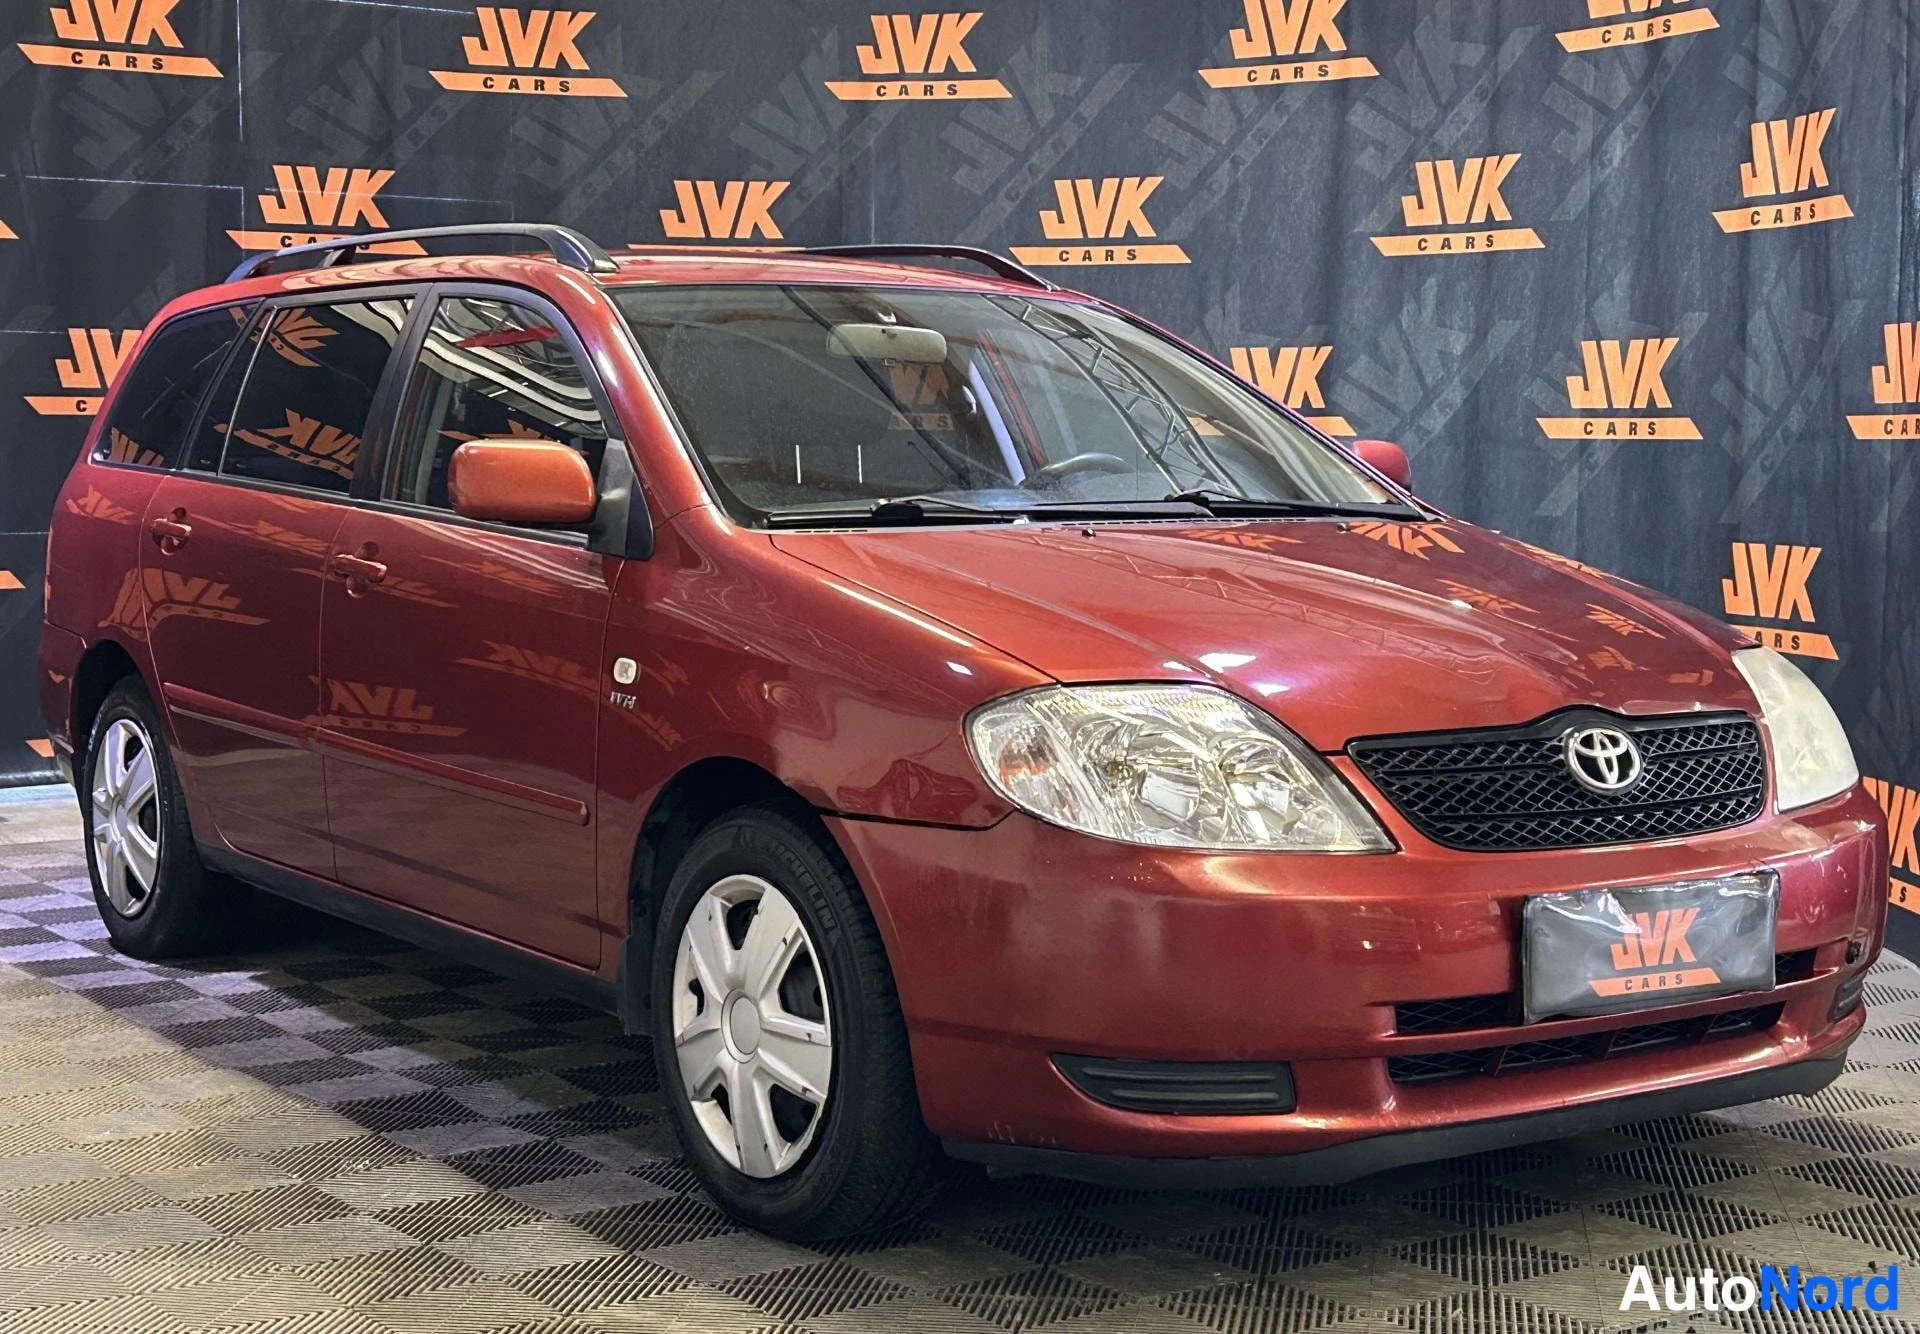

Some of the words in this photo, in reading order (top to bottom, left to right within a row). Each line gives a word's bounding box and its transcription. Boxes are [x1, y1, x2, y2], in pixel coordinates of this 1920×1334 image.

[50, 0, 184, 48] JVK
[461, 7, 598, 70] JVK
[856, 12, 984, 74] JVK
[1229, 0, 1347, 59] JVK
[1601, 18, 1672, 44] CARS
[71, 51, 165, 70] CARS
[482, 76, 571, 93] CARS
[1245, 64, 1328, 83] CARS
[876, 83, 958, 98] CARS
[1740, 107, 1837, 198] JVK
[258, 164, 396, 229] JVK
[659, 179, 791, 239] JVK
[1039, 176, 1164, 239] JVK
[1401, 153, 1523, 227] JVK
[1750, 203, 1816, 226] CARS
[1058, 248, 1137, 262] CARS
[1417, 233, 1494, 252] CARS
[55, 328, 142, 389] JV
[1566, 336, 1680, 409] JVK
[1871, 321, 1920, 404] JV
[1583, 421, 1656, 436] CARS
[1884, 420, 1920, 435] CAR
[1721, 541, 1823, 623] JVK
[1754, 630, 1801, 652] ARS
[1610, 907, 1700, 970] JVK
[1625, 974, 1684, 991] CARS
